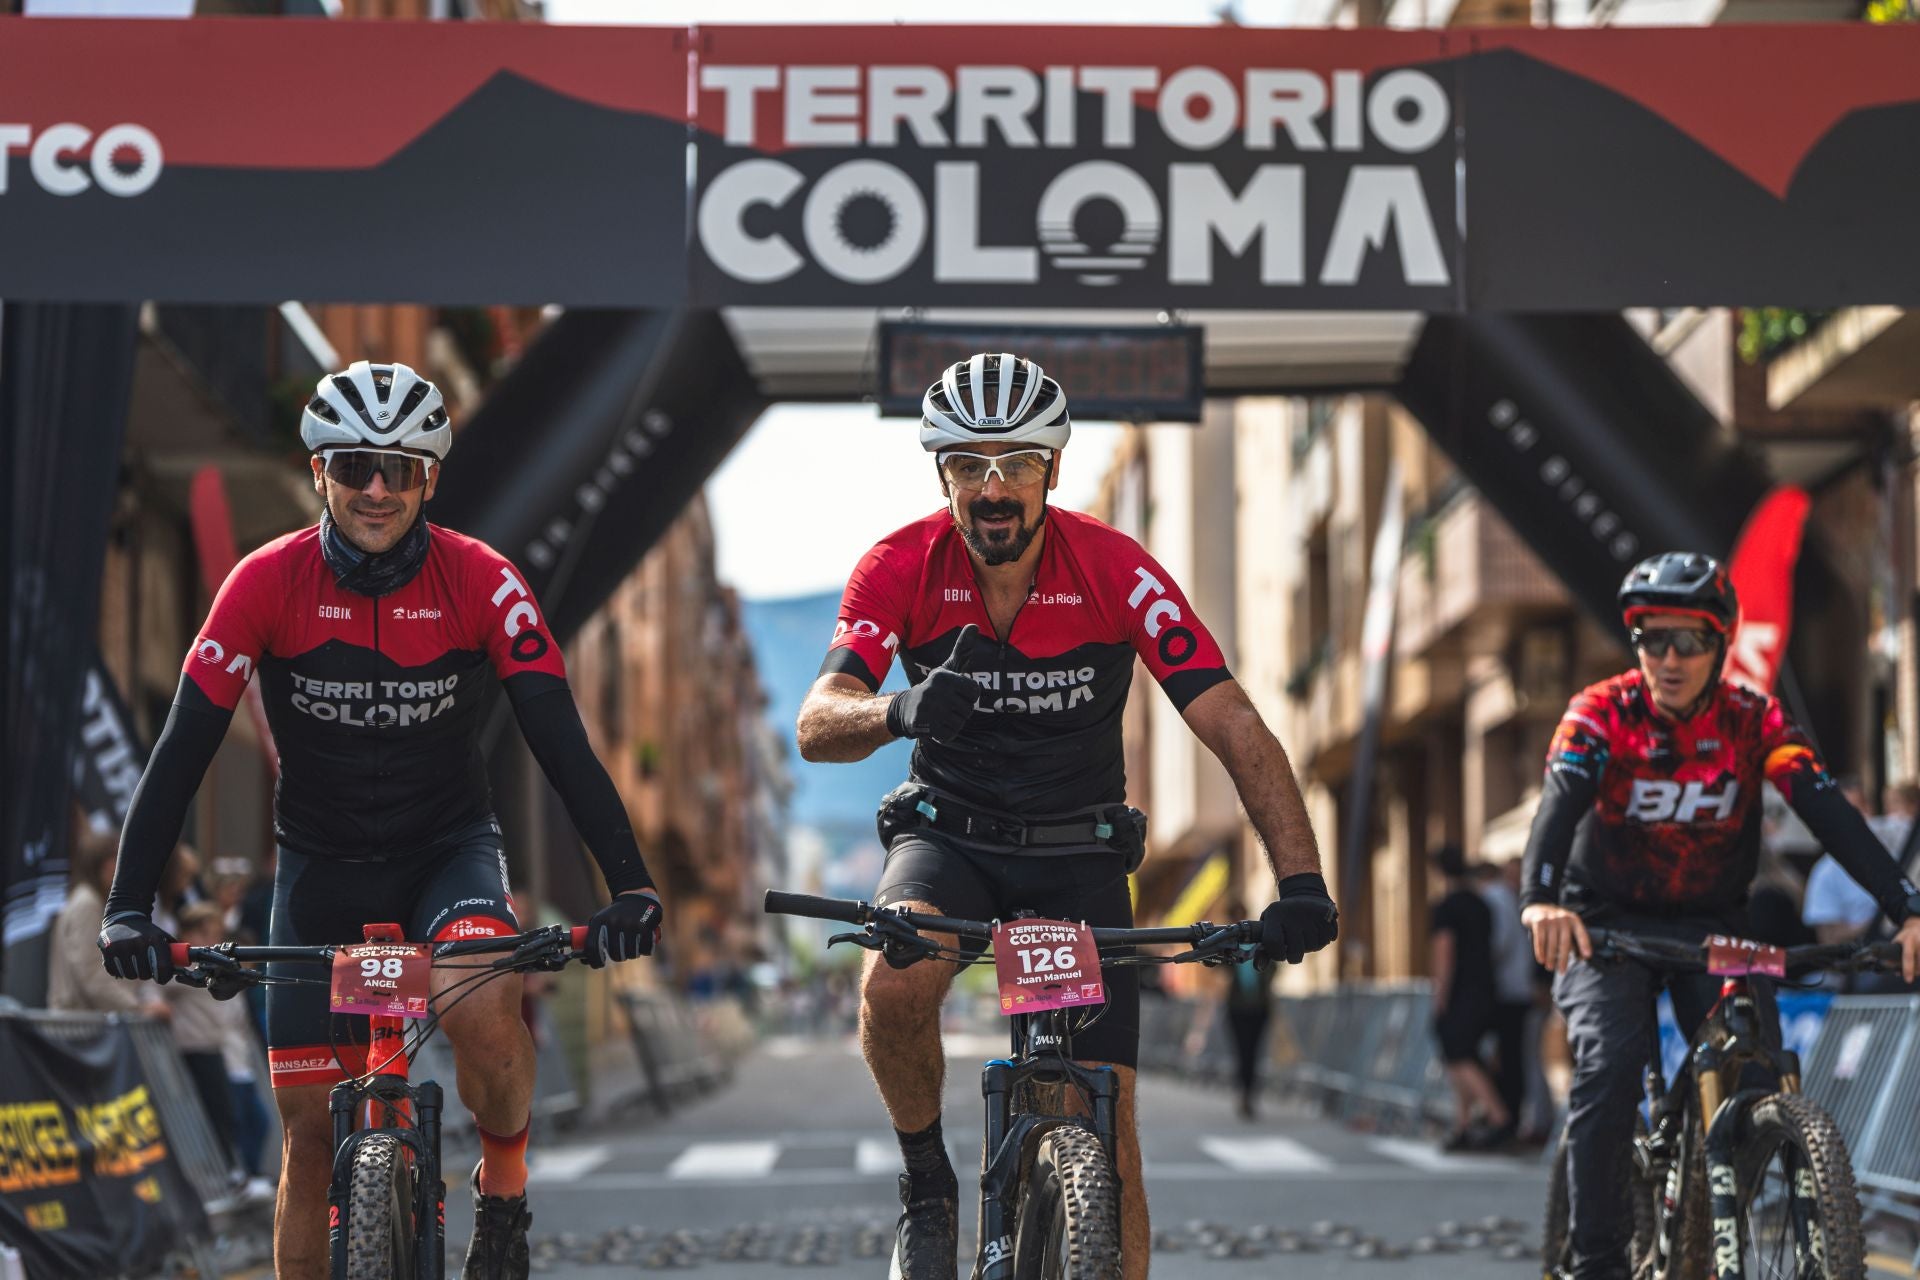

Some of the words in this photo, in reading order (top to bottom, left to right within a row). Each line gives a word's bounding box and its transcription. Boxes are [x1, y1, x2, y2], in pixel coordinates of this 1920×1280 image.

[700, 64, 1450, 152] TERRITORIO
[697, 158, 1451, 286] COLOMA
[1042, 594, 1055, 604] La
[1056, 593, 1082, 606] Rioja
[318, 605, 352, 619] GOBIK
[407, 609, 418, 619] La
[419, 607, 442, 620] Rioja
[491, 567, 548, 662] TCO
[1127, 566, 1198, 667] TCO
[290, 692, 455, 728] COLOMA
[1625, 779, 1738, 822] BH
[1008, 925, 1077, 935] TERRITORIO
[1010, 932, 1078, 945] COLOMA
[350, 950, 417, 958] COLOMA
[1017, 946, 1076, 974] 126
[360, 958, 403, 978] 98
[364, 979, 398, 989] ANGEL
[1016, 976, 1042, 985] Juan
[1044, 970, 1082, 982] Manuel
[373, 1027, 404, 1041] BH
[1712, 1217, 1740, 1276] FOX
